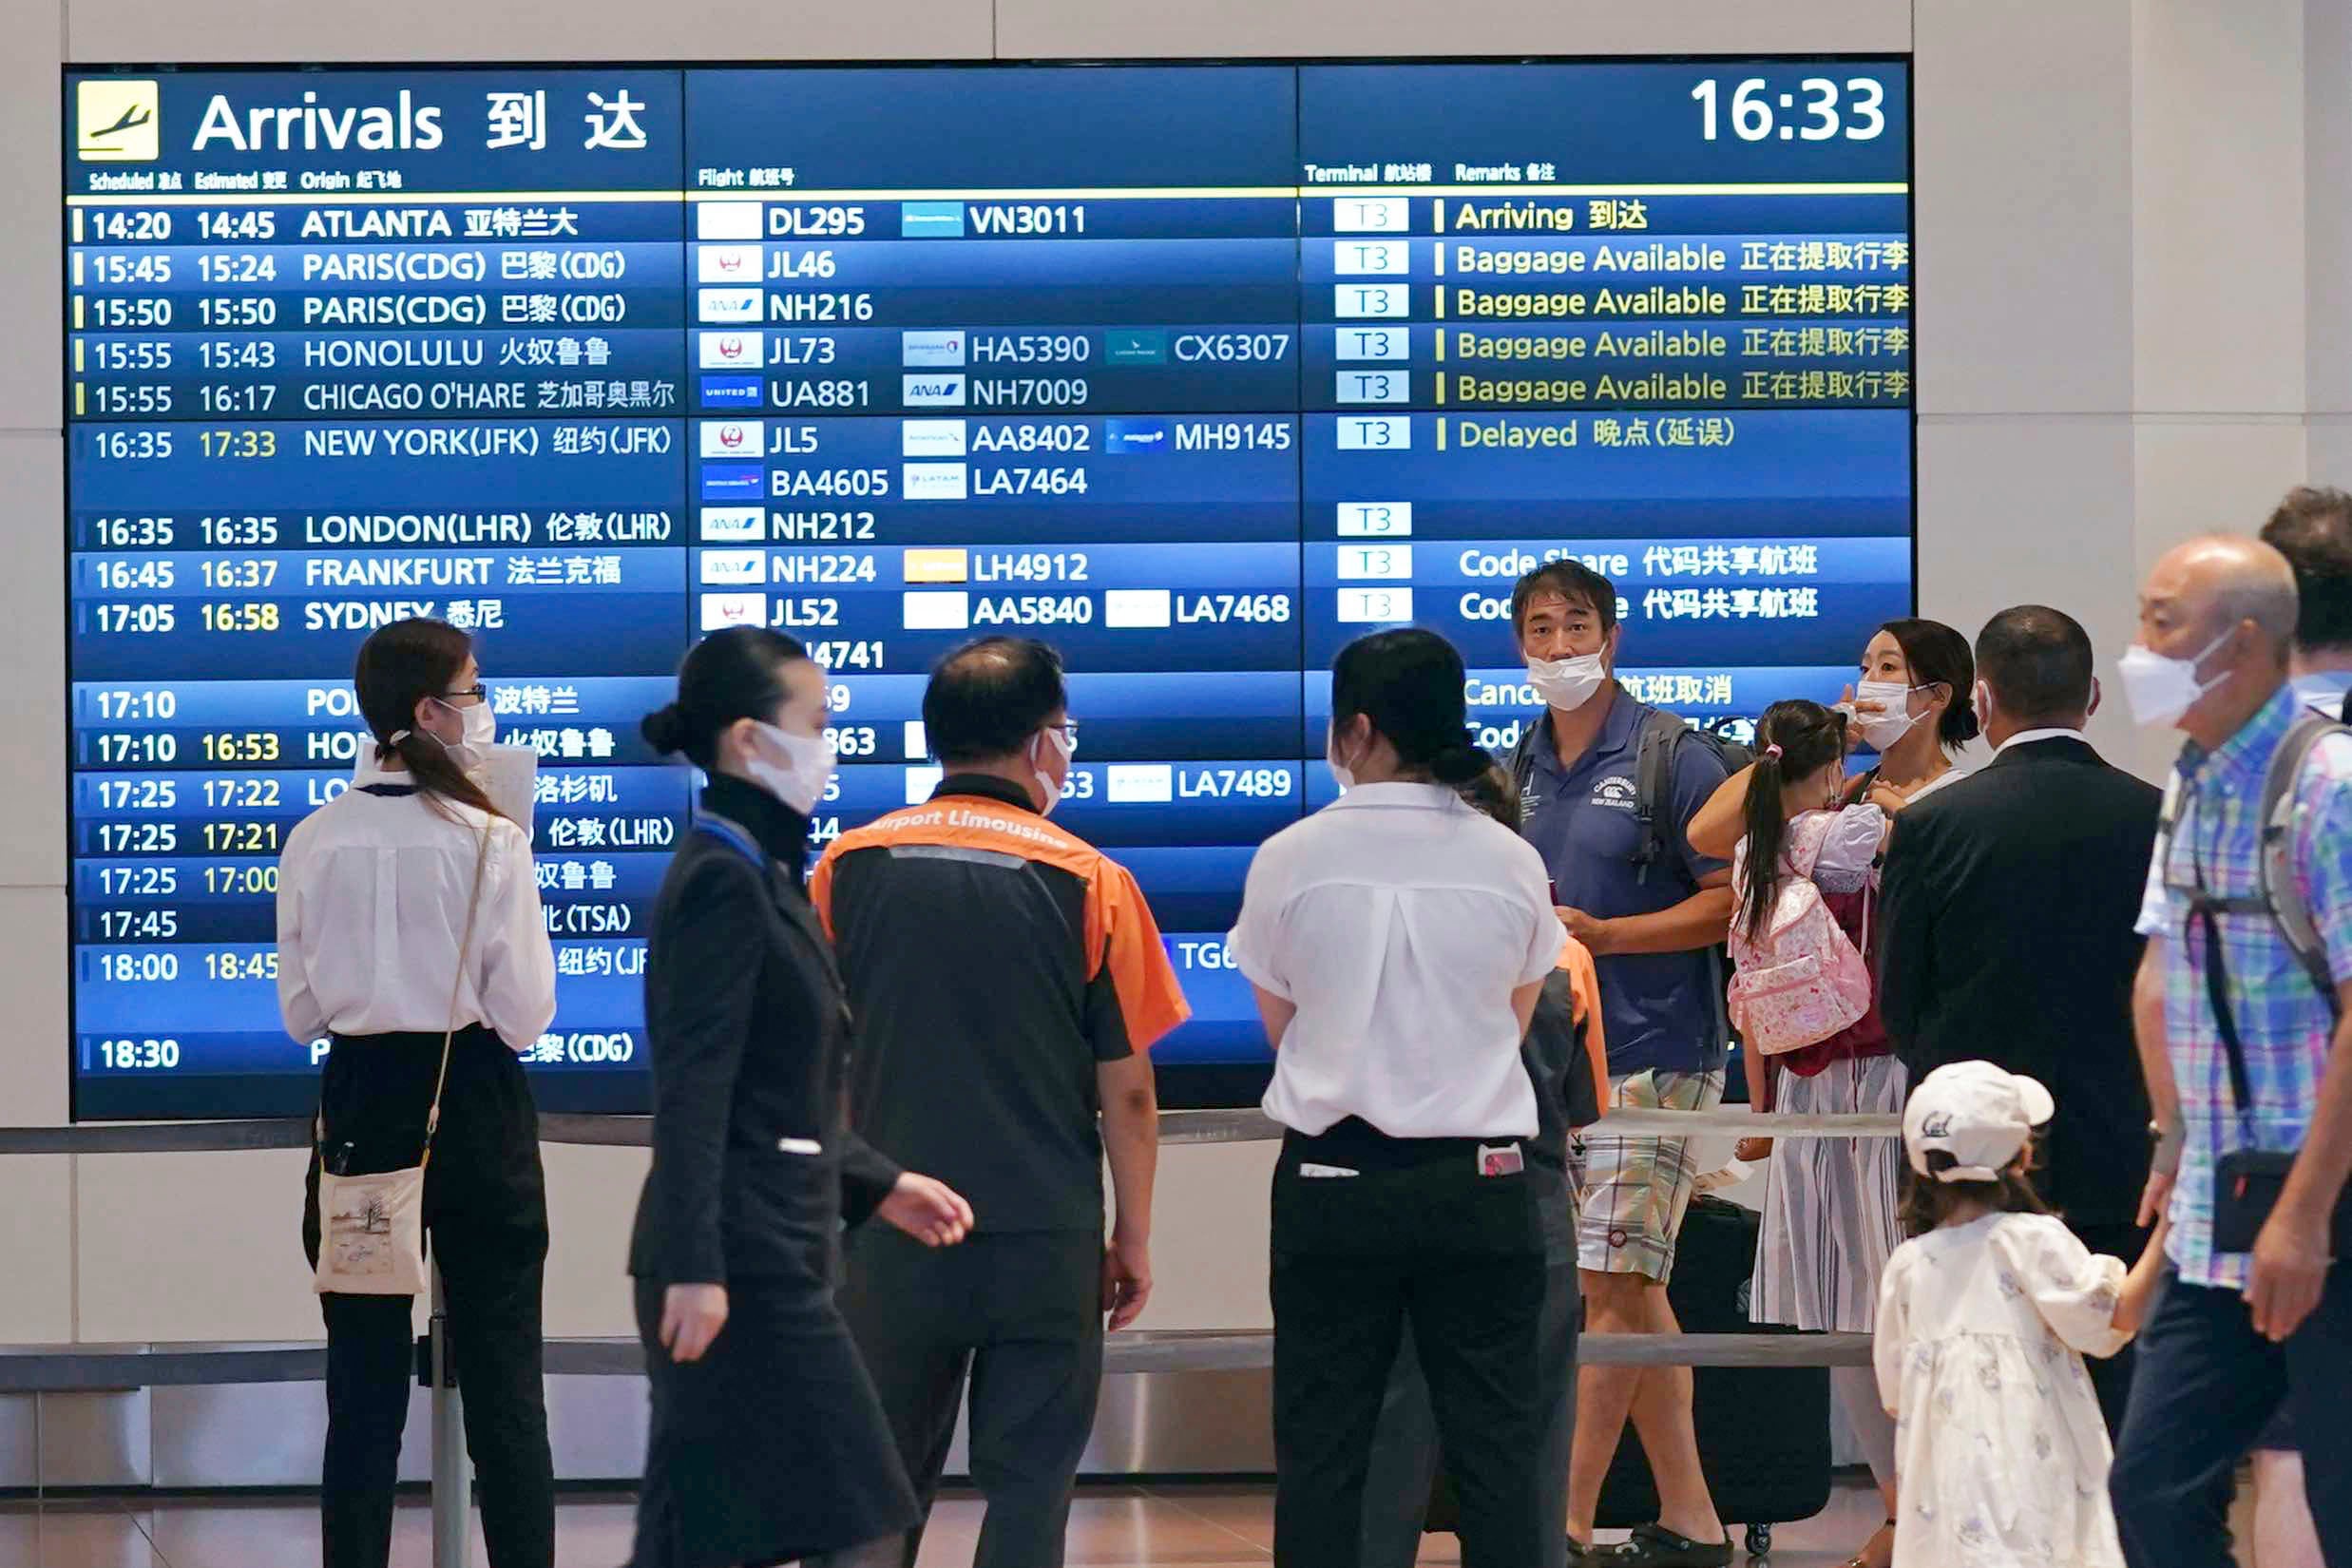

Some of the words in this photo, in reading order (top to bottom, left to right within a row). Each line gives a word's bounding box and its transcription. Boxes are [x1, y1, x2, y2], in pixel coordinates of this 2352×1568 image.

[193, 90, 442, 150] Arrivals
[1692, 79, 1884, 141] 16:33
[90, 172, 153, 190] Scheduled
[195, 171, 258, 189] Estimated
[301, 171, 350, 189] Origin
[699, 168, 744, 186] Flight
[1305, 163, 1377, 182] Terminal
[1456, 163, 1520, 181] Remarks
[1527, 163, 1555, 181] 备注
[94, 212, 171, 239] 14:20
[198, 212, 275, 239] 14:45
[301, 210, 451, 237] ATLANTA
[465, 207, 578, 236] 亚特兰大
[770, 207, 864, 235] DL295
[970, 206, 1083, 233] VN3011
[1354, 204, 1387, 227] T3
[1456, 201, 1573, 230] Arriving
[1590, 200, 1647, 229] 到达
[94, 256, 170, 282] 15:45
[198, 255, 276, 281] 15:24
[304, 251, 486, 281] PARIS(CDG)
[502, 251, 624, 279] 巴黎(CDG)
[768, 251, 834, 277] JL46
[1354, 247, 1387, 270] T3
[1458, 246, 1585, 274] Baggage
[1594, 243, 1725, 271] Available
[1741, 240, 1908, 271] 正在提取行李
[95, 299, 171, 326] 15:50
[200, 298, 276, 325] 15:50
[304, 295, 486, 324] PARIS(CDG)
[503, 294, 625, 322] 巴黎(CDG)
[771, 294, 872, 320] NH216
[1355, 290, 1388, 313] T3
[1459, 290, 1585, 316] Baggage
[1594, 286, 1726, 314] Available
[1741, 283, 1908, 313] 正在提取行李
[96, 343, 171, 369] 15:55
[200, 342, 275, 368] 15:43
[305, 340, 482, 366] HONOLULU
[500, 337, 611, 365] 火奴鲁鲁
[770, 337, 834, 364] JL73
[974, 335, 1089, 362] HA5390
[1176, 335, 1289, 360] CX6307
[1355, 333, 1388, 355] T3
[1459, 333, 1585, 359] Baggage
[1595, 330, 1726, 356] Available
[1742, 327, 1908, 356] 正在提取行李
[96, 387, 171, 411] 15:55
[201, 386, 276, 411] 16:17
[304, 384, 423, 410] CHICAGO
[430, 382, 525, 409] O'HARE
[538, 380, 674, 408] 芝加哥奥黑尔
[705, 387, 746, 397] UNITED
[773, 381, 868, 407] UA881
[909, 385, 944, 396] ANA
[974, 379, 1087, 405] NH7009
[1355, 375, 1388, 398] T3
[1460, 376, 1586, 402] Baggage
[1595, 373, 1726, 399] Available
[1743, 370, 1909, 399] 正在提取行李
[97, 432, 172, 458] 16:35
[201, 431, 275, 457] 17:33
[306, 430, 376, 455] NEW
[383, 427, 538, 456] YORK(JFK)
[553, 426, 670, 454] 纽约(JFK)
[770, 427, 817, 453] JL5
[972, 425, 1089, 451] AA8402
[1176, 424, 1290, 449] MH9145
[1356, 422, 1389, 445] T3
[1461, 419, 1577, 449] Delayed
[1594, 417, 1733, 447] 晚点(延误)
[773, 469, 888, 495] BA4605
[975, 468, 1087, 494] LA7464
[97, 518, 173, 545] 16:35
[201, 517, 277, 544] 16:35
[307, 513, 531, 544] LONDON(LHR)
[546, 512, 670, 541] 伦敦(LHR)
[774, 512, 874, 539] NH212
[1357, 507, 1390, 531] T3
[98, 562, 174, 588] 16:45
[201, 561, 277, 587] 16:37
[307, 558, 494, 585] FRANKFURT
[507, 556, 621, 583] 法兰克福
[773, 555, 876, 583] NH224
[975, 553, 1087, 581] LH4912
[1357, 551, 1390, 573] T3
[1460, 548, 1537, 576] Code
[1643, 545, 1817, 576] 代码共享航班
[98, 604, 174, 632] 17:05
[202, 603, 278, 630] 16:58
[447, 600, 503, 631] 悉尼
[771, 599, 838, 626] JL52
[973, 596, 1092, 624] AA5840
[1177, 595, 1290, 622] LA7468
[1357, 594, 1390, 617] T3
[1643, 587, 1817, 619] 代码共享航班
[99, 691, 175, 717] 17:10
[493, 686, 580, 715] 波特兰
[99, 735, 176, 761] 17:10
[203, 734, 278, 760] 16:53
[100, 780, 176, 808] 17:25
[204, 780, 279, 806] 17:22
[1179, 770, 1291, 796] LA7489
[100, 824, 176, 851] 17:25
[204, 823, 276, 850] 17:21
[549, 817, 673, 846] 伦敦(LHR)
[871, 811, 943, 831] Airport
[948, 809, 1069, 849] Limousine
[101, 868, 176, 893] 17:25
[205, 867, 278, 895] 17:00
[535, 861, 616, 889] 奴鲁鲁
[102, 911, 177, 937] 17:45
[543, 904, 632, 932] 北(TSA)
[102, 954, 178, 981] 18:00
[206, 953, 279, 980] 18:45
[102, 1040, 179, 1067] 18:30
